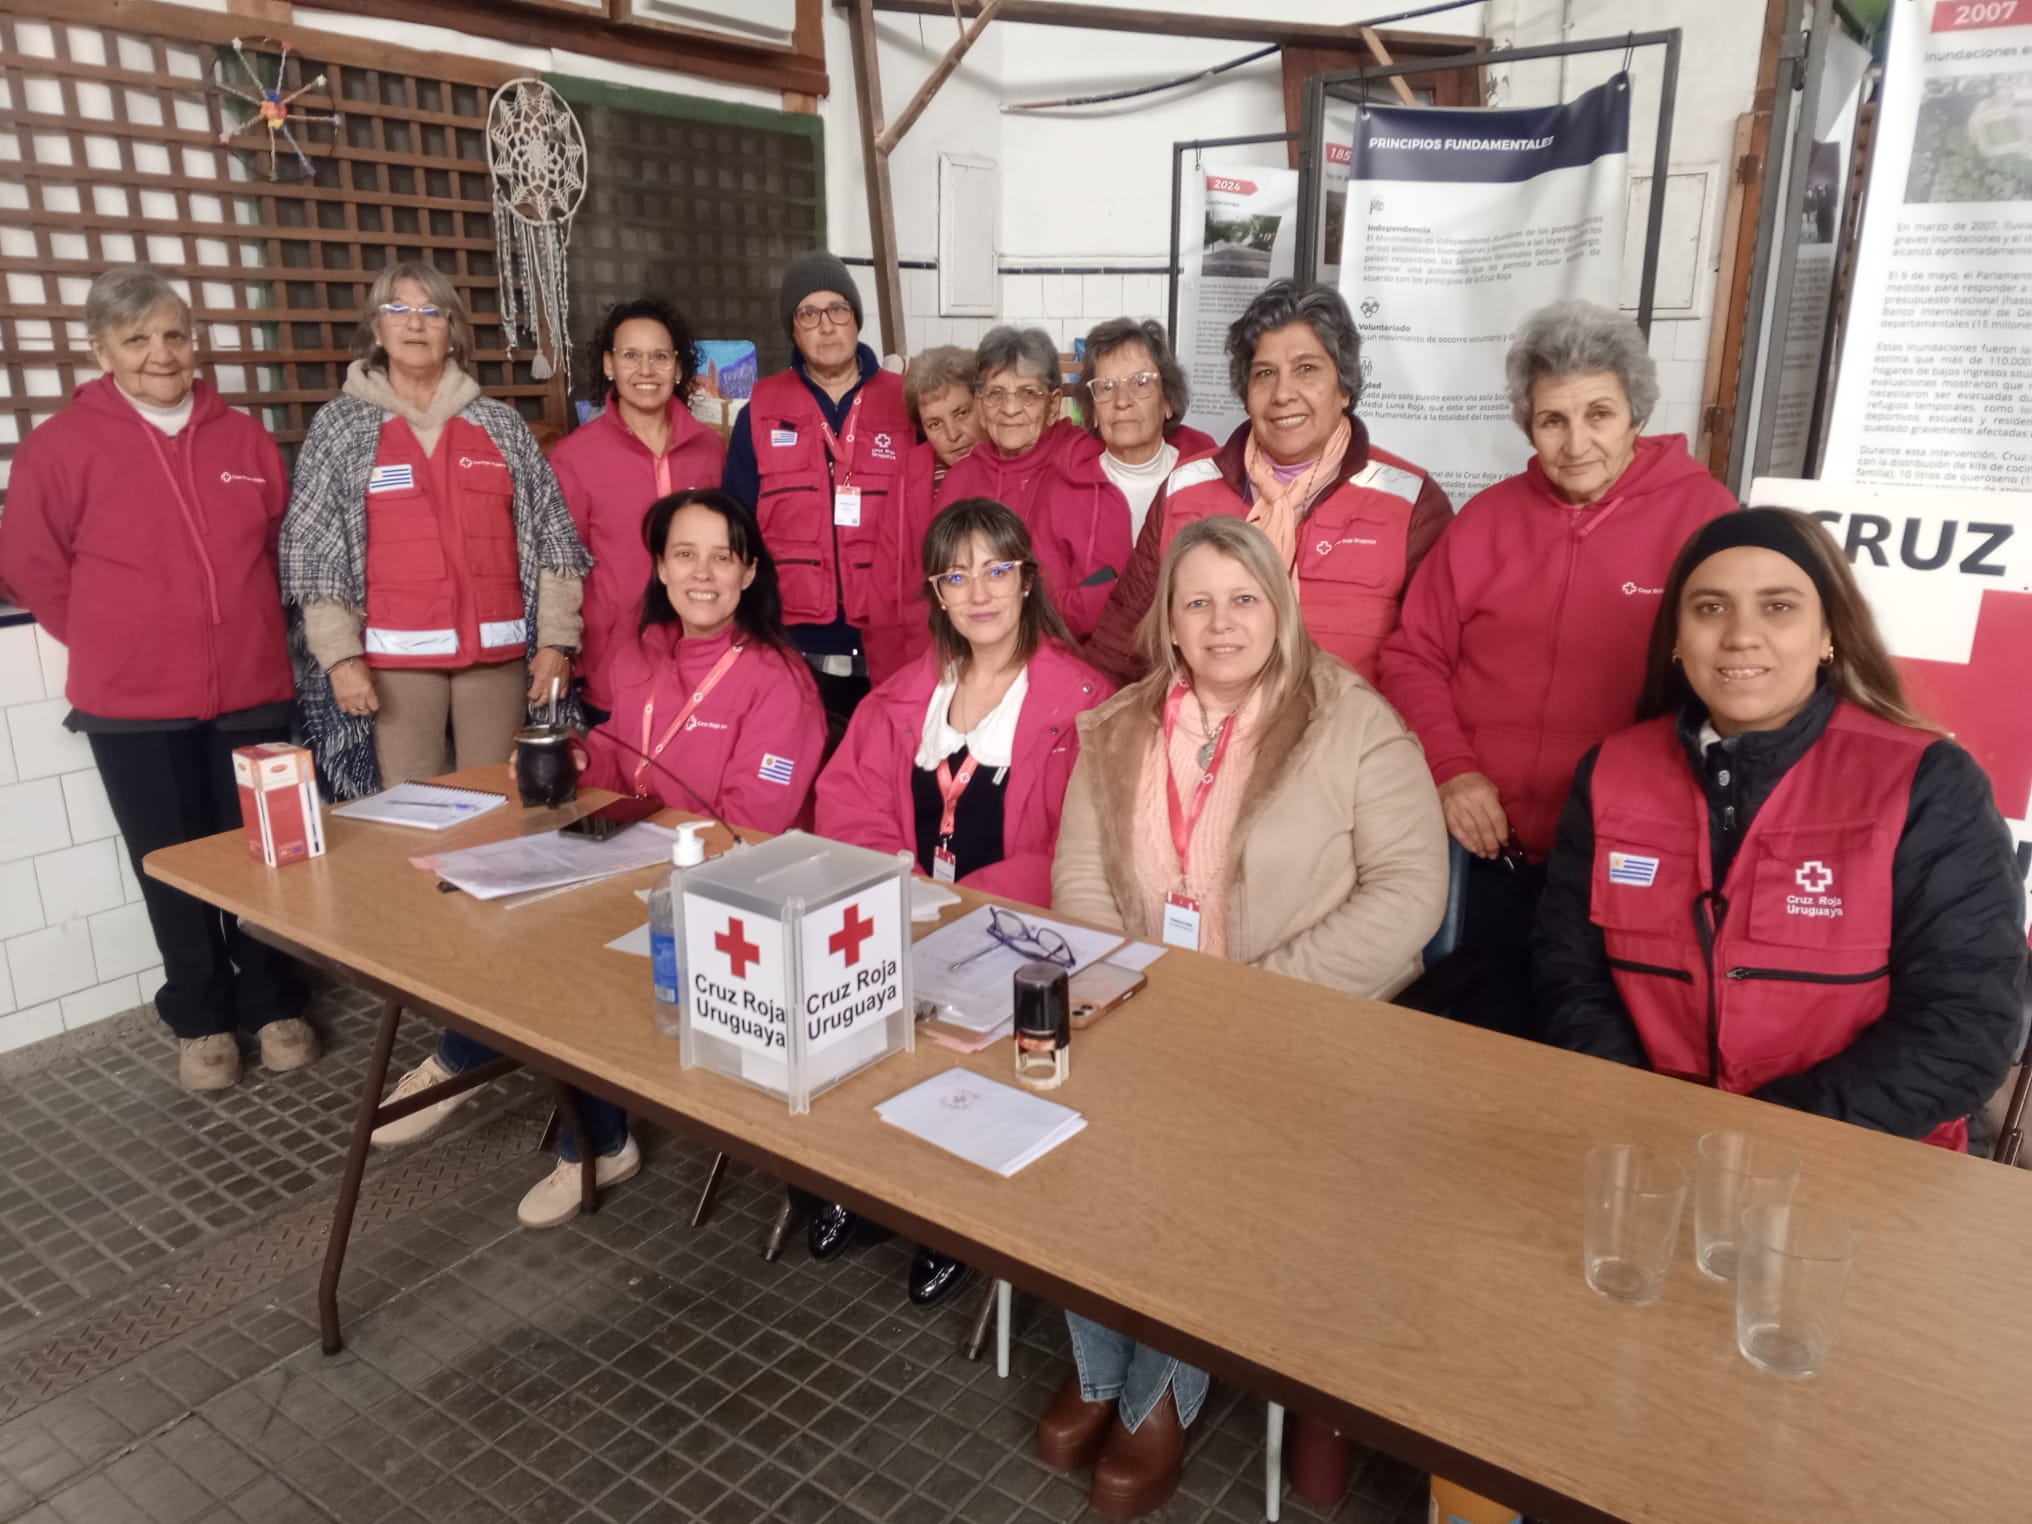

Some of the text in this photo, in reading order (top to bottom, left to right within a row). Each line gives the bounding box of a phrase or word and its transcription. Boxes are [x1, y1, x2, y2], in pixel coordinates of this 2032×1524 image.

[1954, 1, 2018, 25] 2007
[1369, 137, 1442, 149] PRINCIPIOS
[1214, 179, 1240, 191] 2024
[1368, 224, 1431, 233] Independencia
[1915, 223, 1948, 231] marzo
[1953, 222, 1966, 231] de
[1894, 236, 1928, 246] graves
[1932, 234, 2000, 243] inundaciones
[1911, 271, 1923, 280] de
[1963, 271, 1972, 279] el
[1886, 284, 1931, 292] medidas
[1935, 285, 1958, 293] para
[1962, 284, 2017, 294] responder
[1884, 296, 1950, 305] presupuesto
[1955, 296, 1998, 304] nacional
[1883, 308, 1914, 316] Banco
[1921, 308, 1991, 316] Internacional
[1997, 308, 2010, 316] de
[1359, 324, 1411, 332] Voluntariado
[1880, 320, 1969, 329] departamentales
[1972, 320, 1988, 329] (15
[1379, 334, 1424, 342] movimiento
[1877, 343, 2016, 354] Estas inundaciones fueron
[1874, 355, 1909, 363] estima
[1915, 357, 1935, 365] que
[1969, 356, 1982, 364] de
[1873, 367, 1913, 377] hogares
[1932, 368, 1960, 377] bajos
[1963, 368, 2007, 378] ingresos
[1871, 379, 2023, 390] evaluaciones mostraron que
[1869, 390, 1928, 398] necesitaron
[1935, 391, 1951, 399] ser
[1867, 401, 1908, 411] refugios
[1984, 404, 2013, 413] como
[1376, 411, 1422, 419] humanitaria
[1439, 412, 1472, 421] totalidad
[1473, 413, 1483, 421] del
[1929, 414, 1973, 423] escuelas
[1980, 417, 1986, 425] y
[1863, 424, 2027, 437] quedado gravemente afectadas
[1859, 446, 1901, 455] Durante
[1905, 447, 1926, 456] esta
[2002, 451, 2026, 461] Cruz
[1879, 458, 1887, 466] la
[1890, 457, 1950, 468] distribución
[1953, 460, 1966, 469] de
[1969, 461, 1987, 470] kits
[1990, 463, 2003, 471] de
[1915, 470, 1940, 479] litros
[1944, 472, 1956, 481] de
[1960, 473, 2017, 483] queroseno
[1787, 895, 1842, 907] Cruz Roja
[1787, 904, 1843, 918] Uruguaya
[806, 960, 896, 1015] Cruz Roja
[695, 974, 785, 1023] Cruz Roja
[808, 983, 896, 1040] Uruguaya
[697, 997, 785, 1047] Uruguaya
